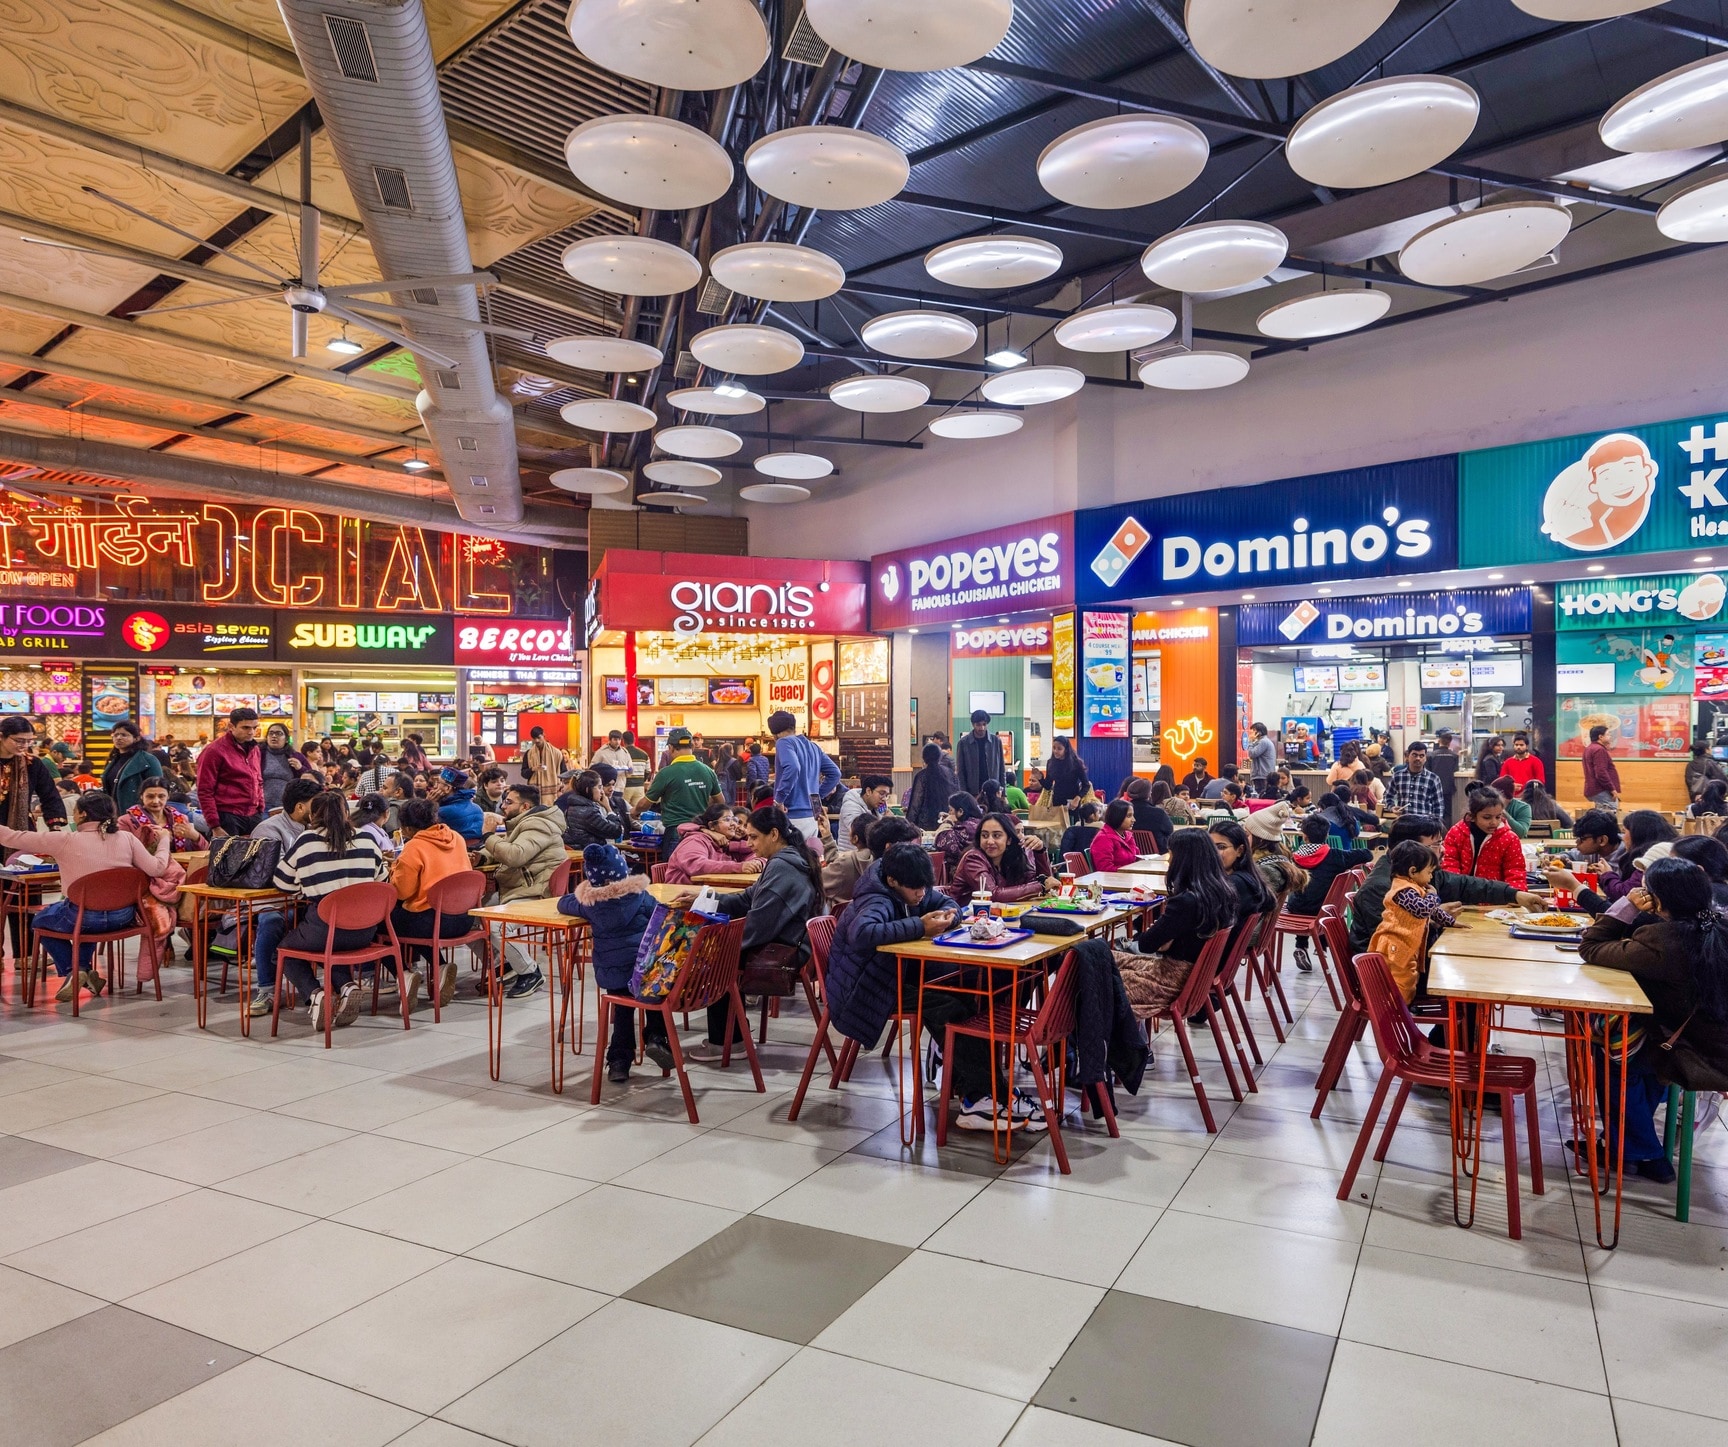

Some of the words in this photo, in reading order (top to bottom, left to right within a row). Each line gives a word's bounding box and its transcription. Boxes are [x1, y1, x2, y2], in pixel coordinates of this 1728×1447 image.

[1162, 506, 1432, 581] Domino's
[910, 532, 1060, 596] POPEYES
[26, 572, 74, 587] OPEN
[911, 593, 952, 611] FAMOUS
[952, 583, 1009, 606] LOUISIANA
[1009, 574, 1061, 597] CHICKEN
[1559, 589, 1678, 616] HONG'S
[15, 604, 105, 628] FOODS
[670, 581, 814, 637] giani's
[3, 626, 18, 637] by
[174, 622, 214, 634] asia
[216, 624, 270, 635] seven
[719, 615, 768, 628] since
[772, 619, 806, 629] 1956
[1327, 605, 1484, 639] Domino's
[22, 637, 69, 649] GRILL
[288, 623, 437, 649] SUBWAY
[955, 626, 1048, 650] POPEYES
[1158, 626, 1209, 640] CHICKEN
[518, 653, 531, 661] You
[532, 653, 550, 661] Love
[470, 671, 509, 680] CHINESE
[515, 671, 537, 681] THAI
[542, 672, 578, 681] SIZZLER
[769, 662, 805, 682] LOVE
[769, 684, 805, 702] Legacy
